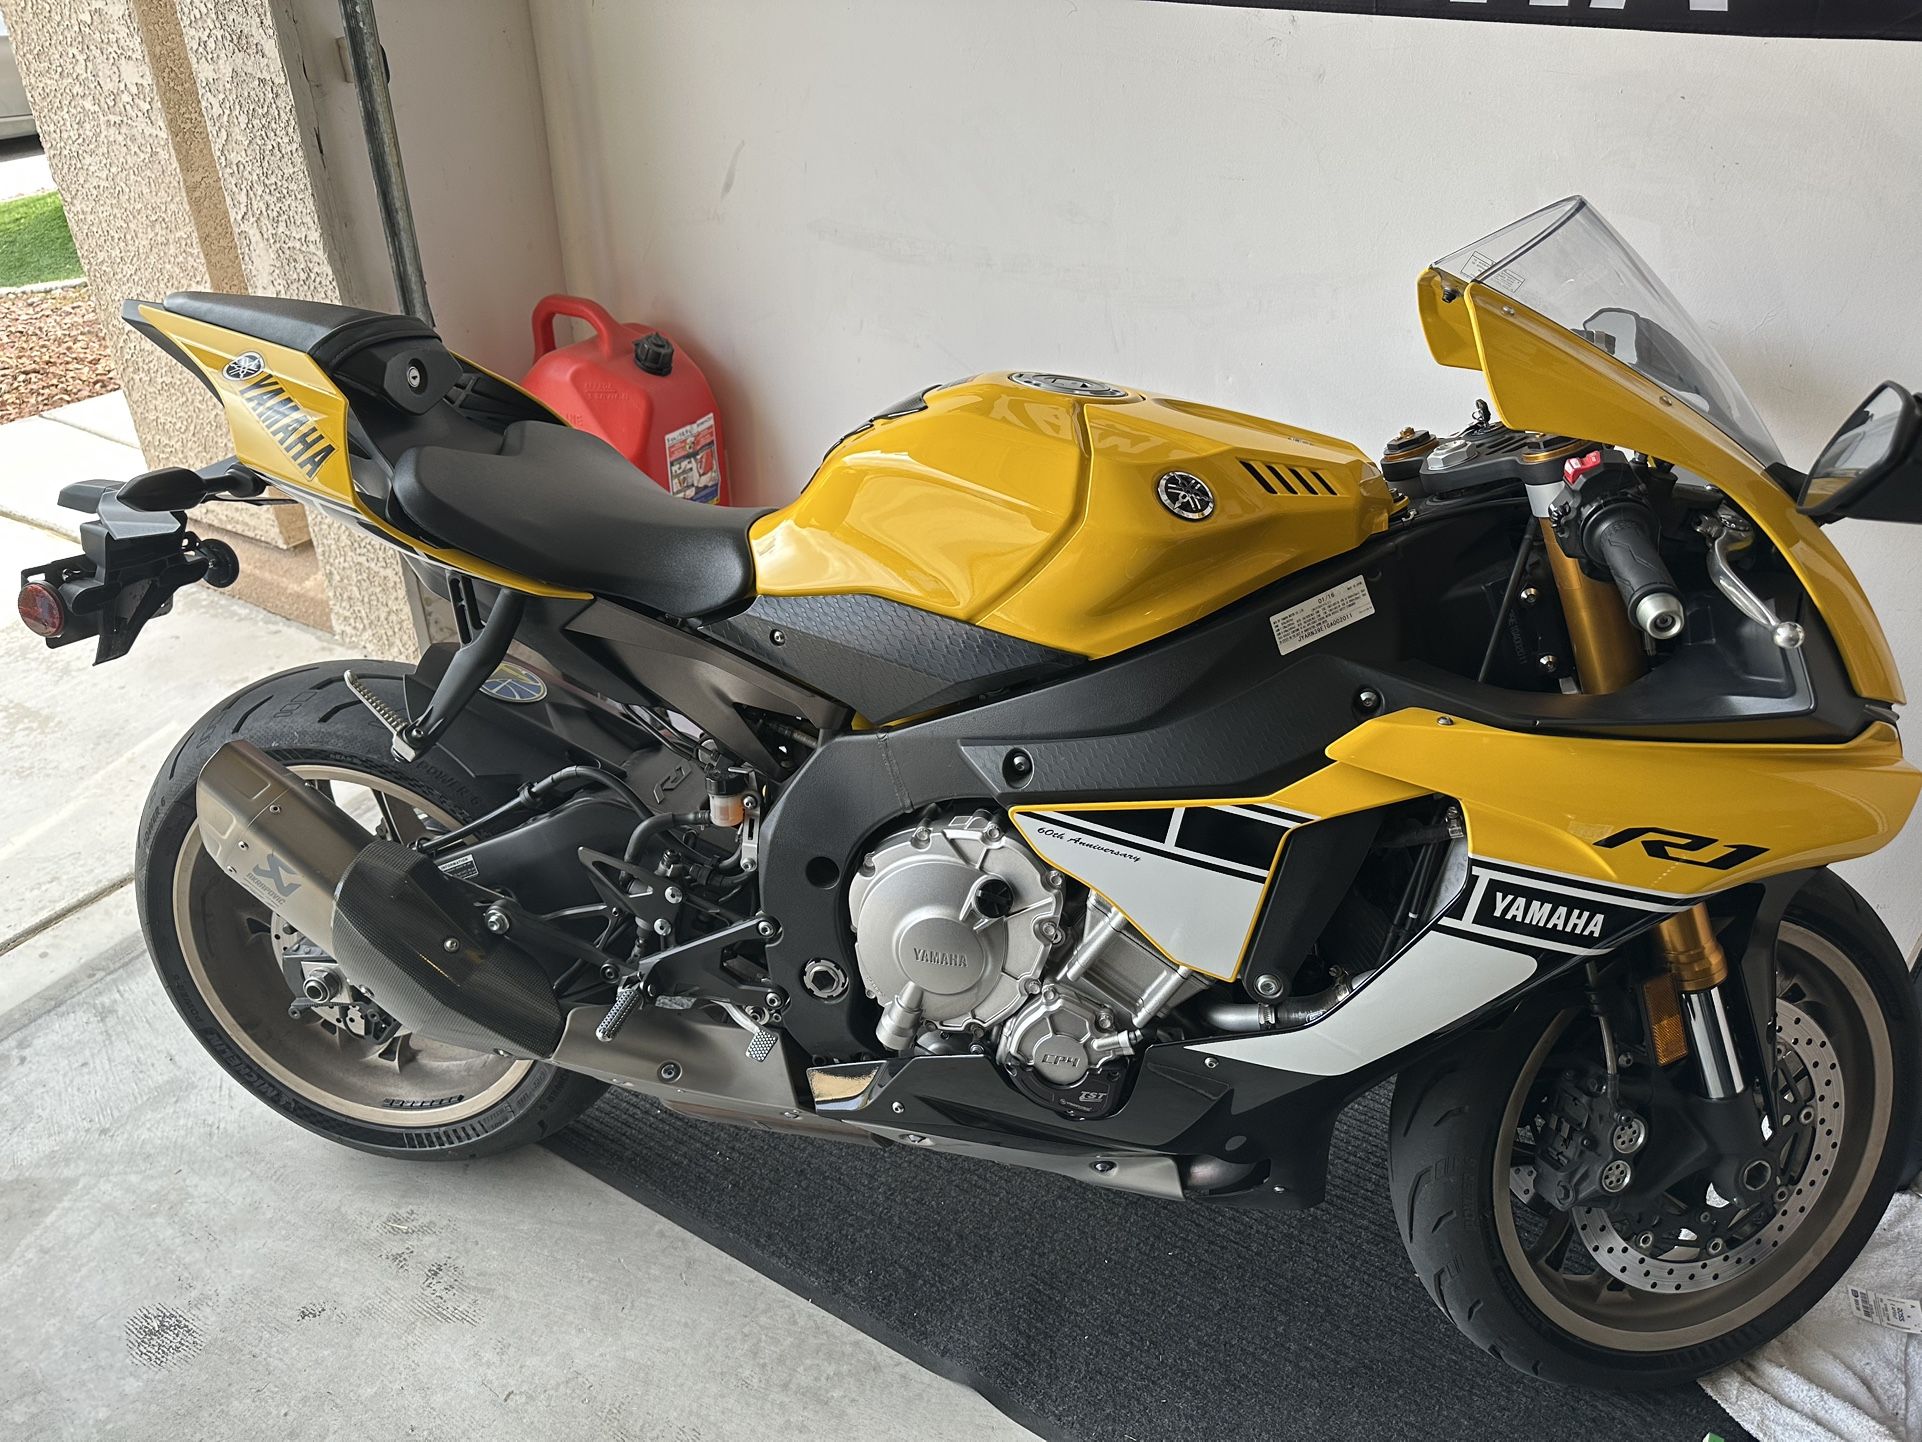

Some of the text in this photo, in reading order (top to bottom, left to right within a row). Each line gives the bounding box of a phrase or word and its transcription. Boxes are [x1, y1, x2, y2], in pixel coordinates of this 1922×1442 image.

[239, 373, 336, 479] YAMAHA
[1037, 826, 1142, 863] 60th Anniversary
[1592, 826, 1771, 871] R1
[1492, 891, 1605, 938] YAMAHA
[912, 947, 969, 968] YAMAHA
[206, 1031, 276, 1098] MICHELIN
